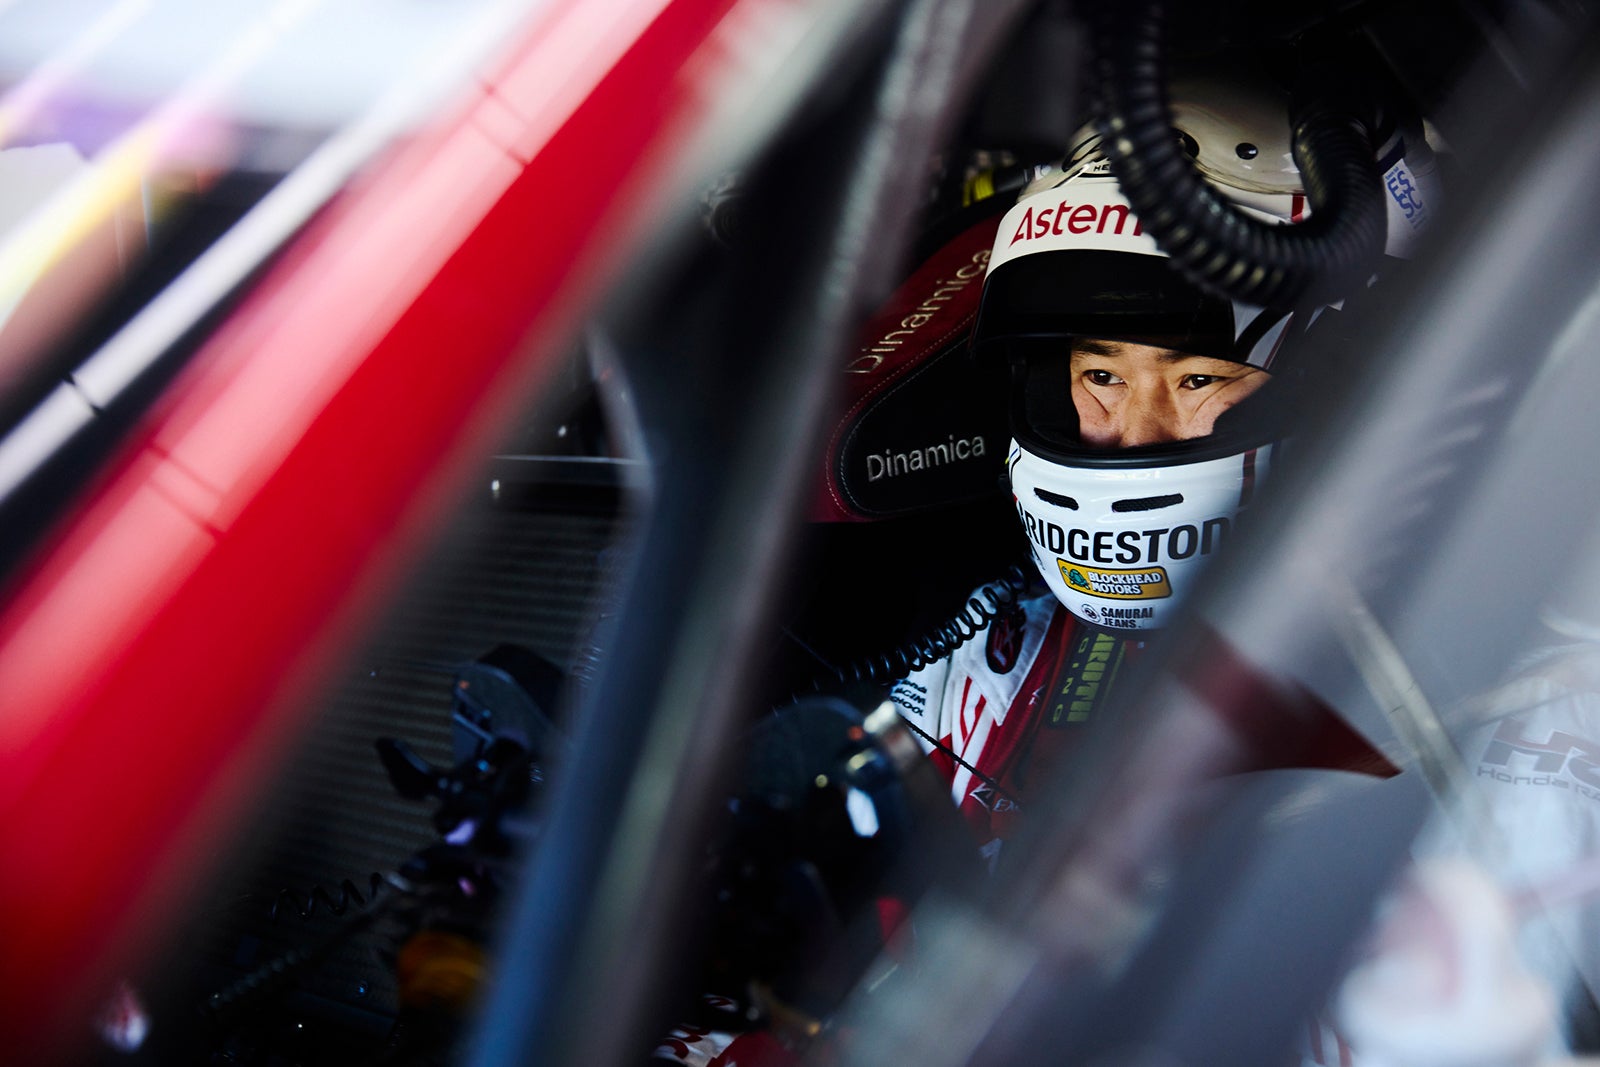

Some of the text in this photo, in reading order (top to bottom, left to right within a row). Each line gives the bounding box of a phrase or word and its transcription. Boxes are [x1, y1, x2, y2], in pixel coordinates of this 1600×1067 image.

[1008, 199, 1145, 249] Astem
[844, 249, 991, 374] Dinamica
[866, 433, 985, 482] Dinamica
[1018, 500, 1233, 565] RIDGESTON
[1087, 571, 1163, 584] BLOCKHEAD
[1091, 581, 1142, 595] MOTORS
[1101, 607, 1153, 619] SAMURAI
[1477, 766, 1569, 789] Honda
